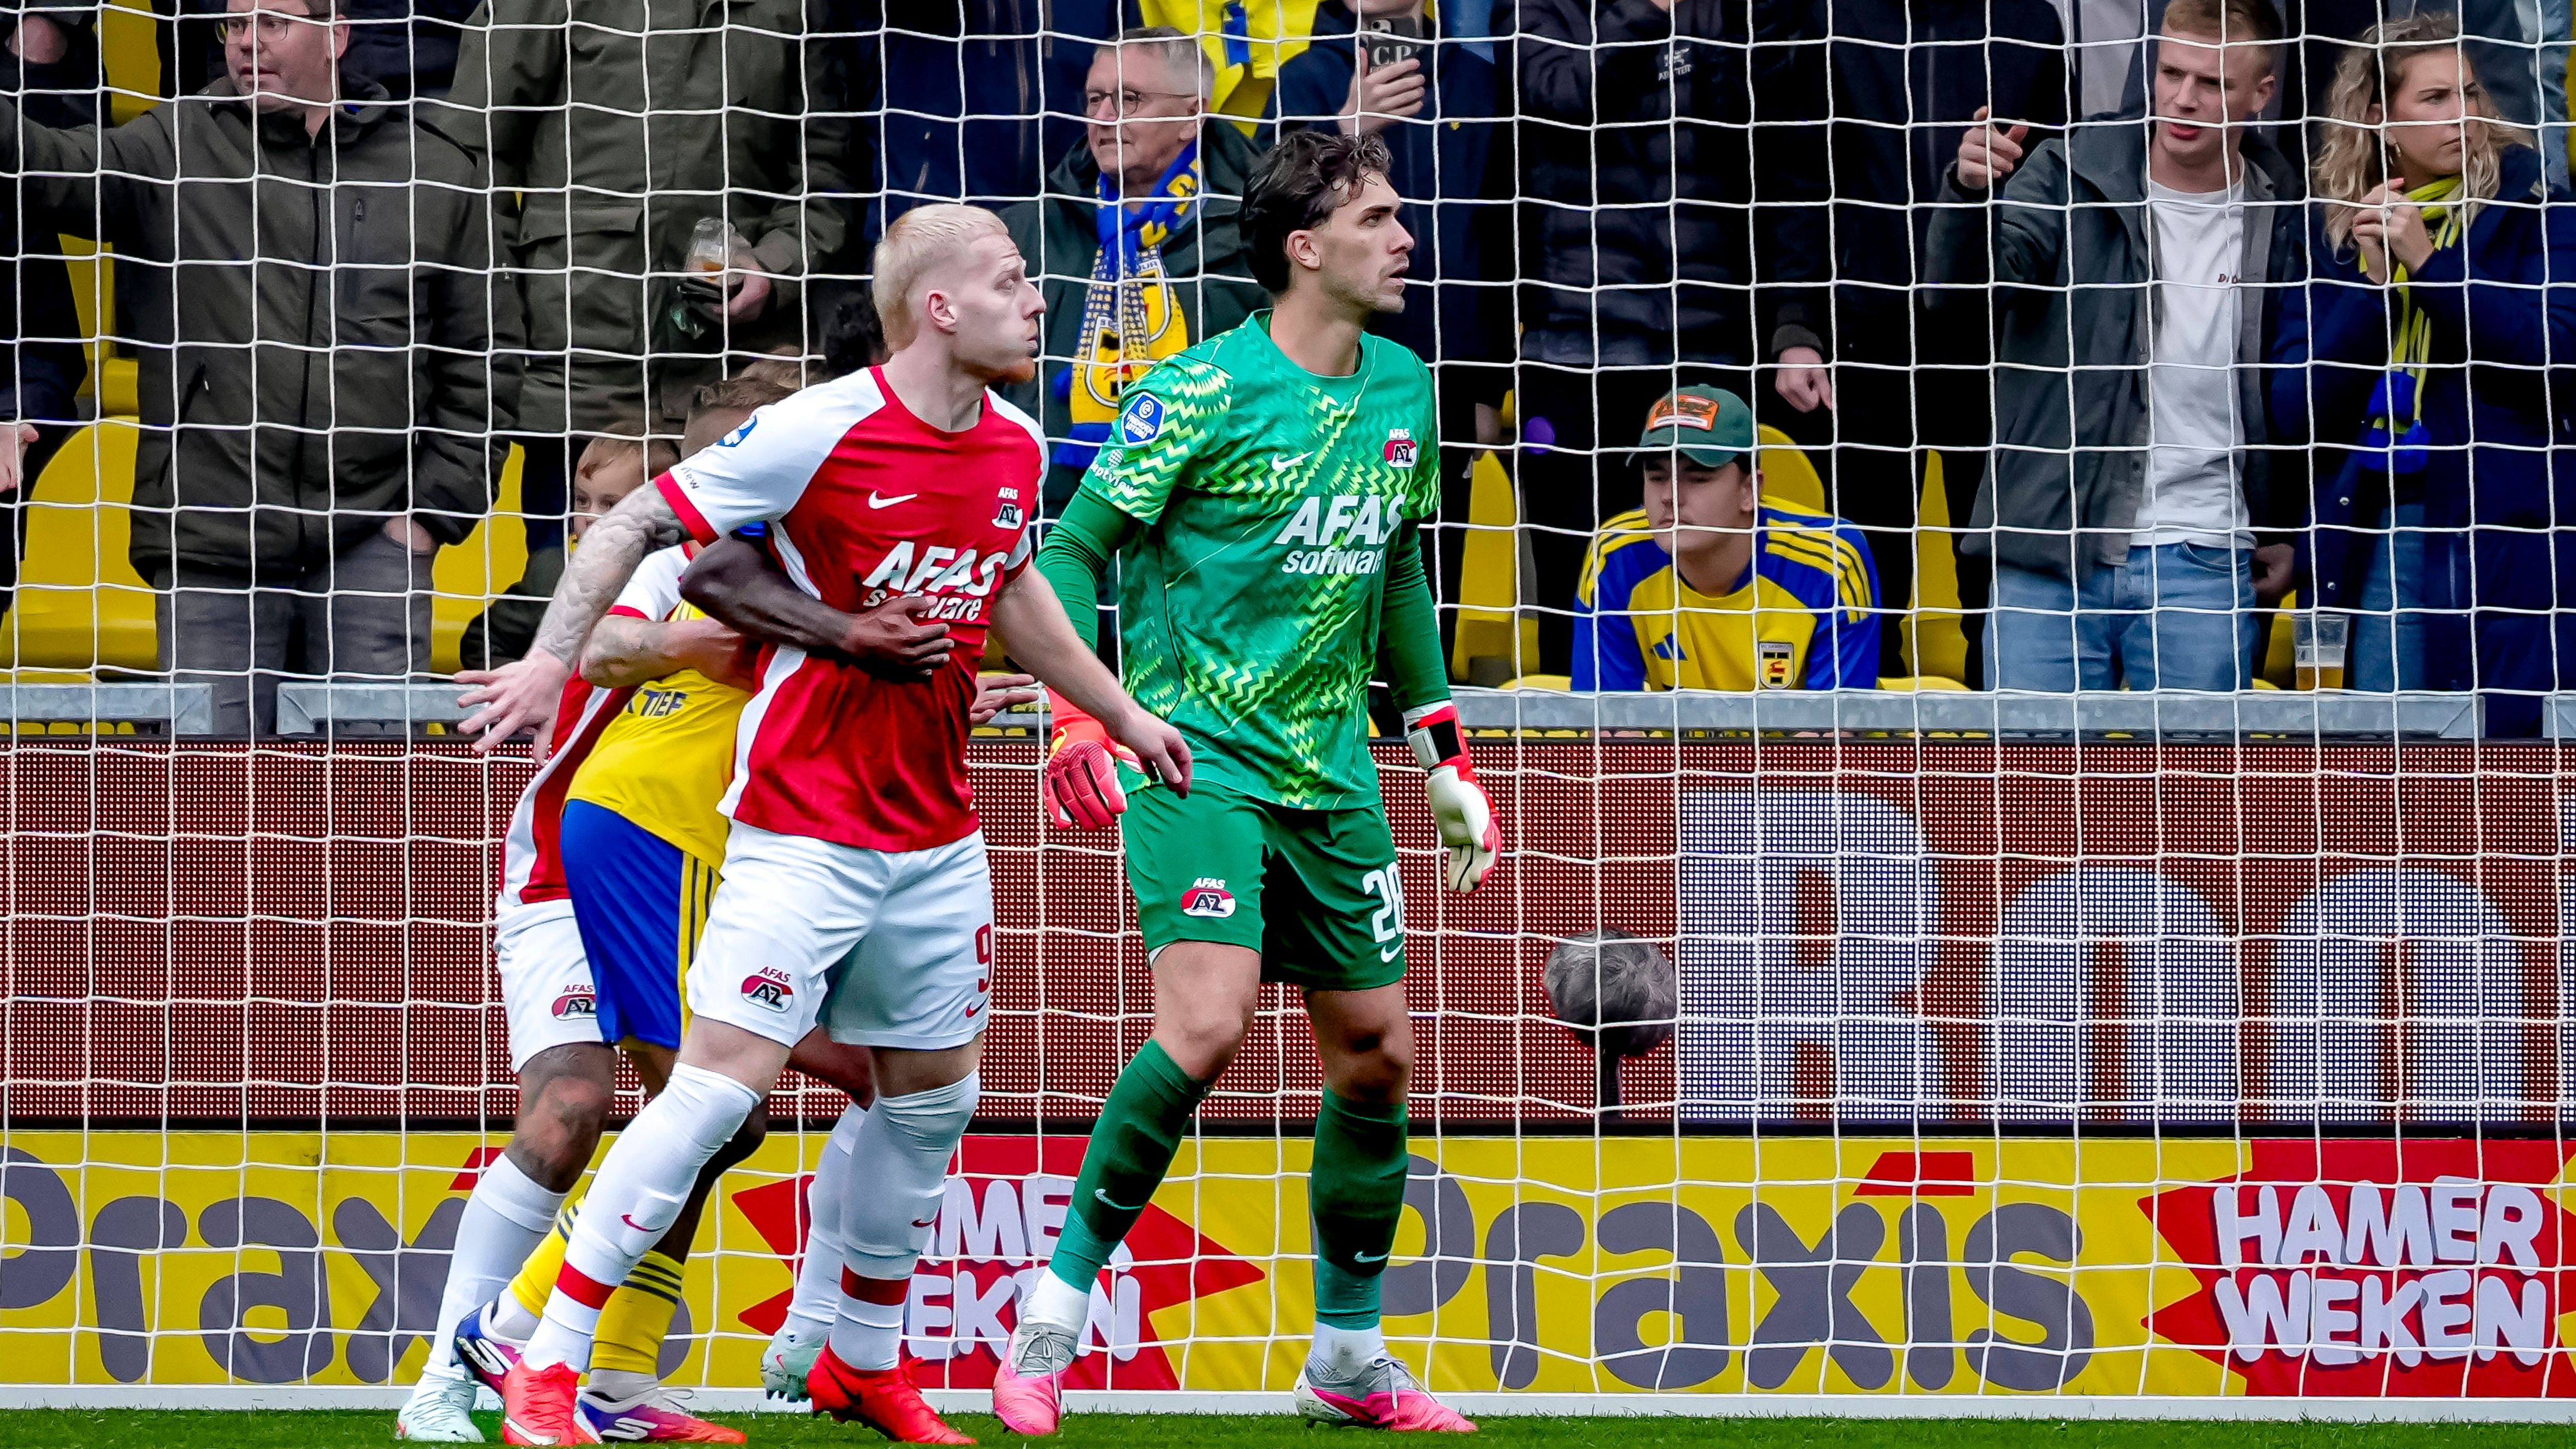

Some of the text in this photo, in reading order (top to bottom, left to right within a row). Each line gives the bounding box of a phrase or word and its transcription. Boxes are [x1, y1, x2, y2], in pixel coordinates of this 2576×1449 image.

[1388, 428, 1410, 439] AFAS
[1392, 444, 1412, 463] AZ
[997, 486, 1018, 500] AFAS
[1273, 494, 1406, 546] AFAS
[862, 540, 1009, 597] AFAS
[1192, 877, 1226, 889] AFAS
[1190, 893, 1226, 913] AZ
[1362, 861, 1405, 944] 28
[975, 922, 992, 993] 9
[758, 966, 791, 983] AFAS
[563, 984, 594, 993] AFAS
[748, 983, 783, 1008] AZ
[2213, 1175, 2543, 1276] HAMER
[2215, 1269, 2546, 1367] WEKEN
